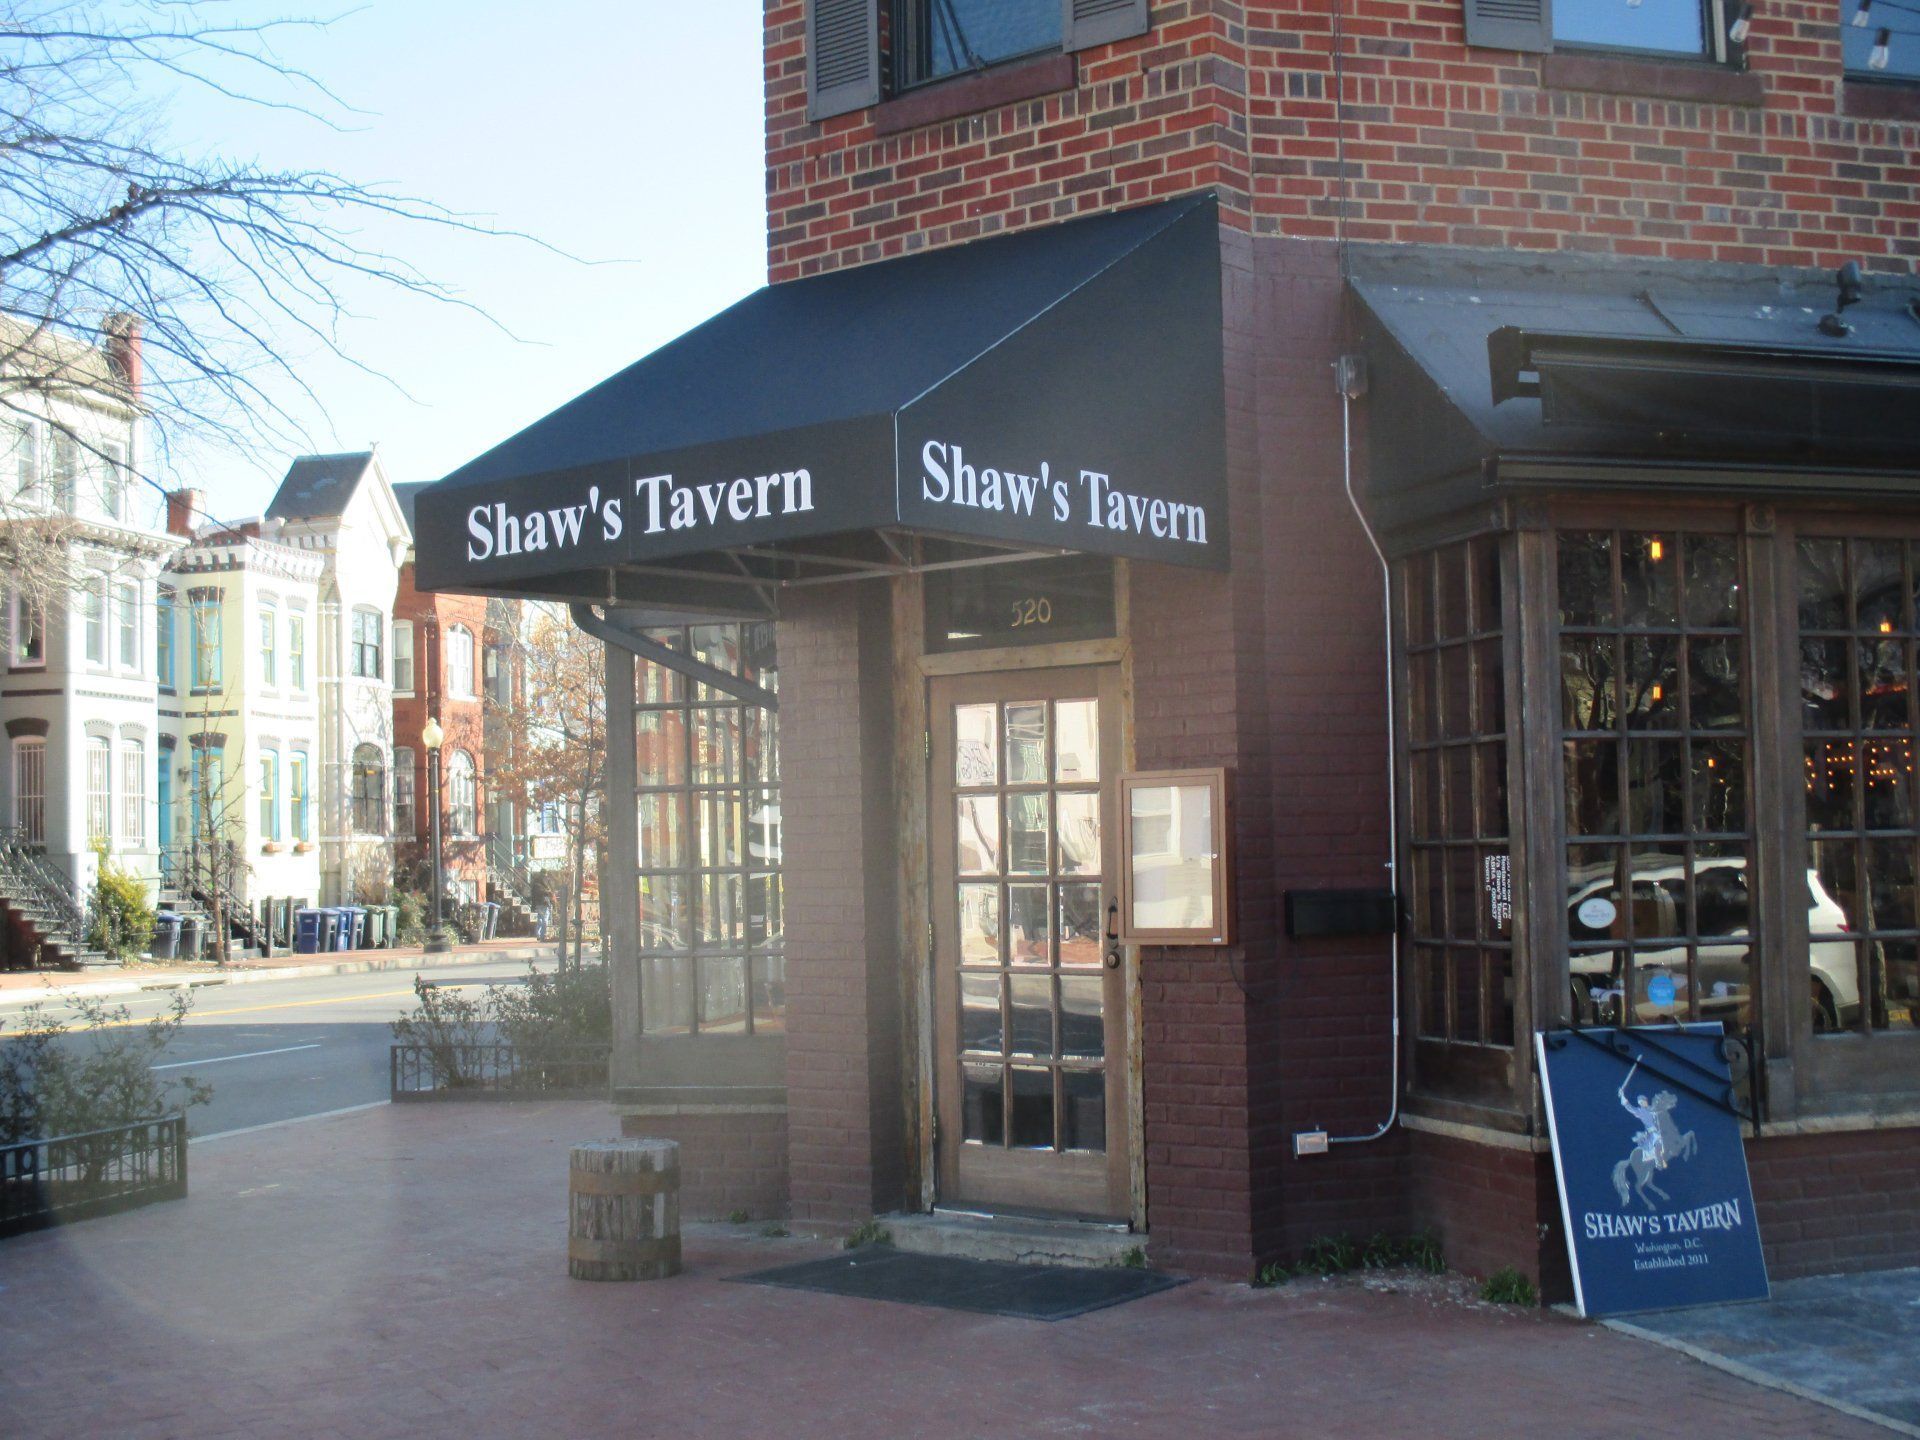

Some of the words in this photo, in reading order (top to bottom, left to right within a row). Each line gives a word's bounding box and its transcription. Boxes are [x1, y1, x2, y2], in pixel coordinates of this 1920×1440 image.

[922, 440, 1070, 522] Shaw's
[1080, 469, 1208, 544] Tavern
[467, 486, 623, 562] Shaw's
[636, 468, 815, 534] Tavern
[1010, 597, 1052, 627] 520
[1584, 1212, 1661, 1239] SHAW'S
[1663, 1198, 1742, 1231] TAVERN
[1634, 1256, 1686, 1271] Established
[1687, 1253, 1709, 1266] 2011
